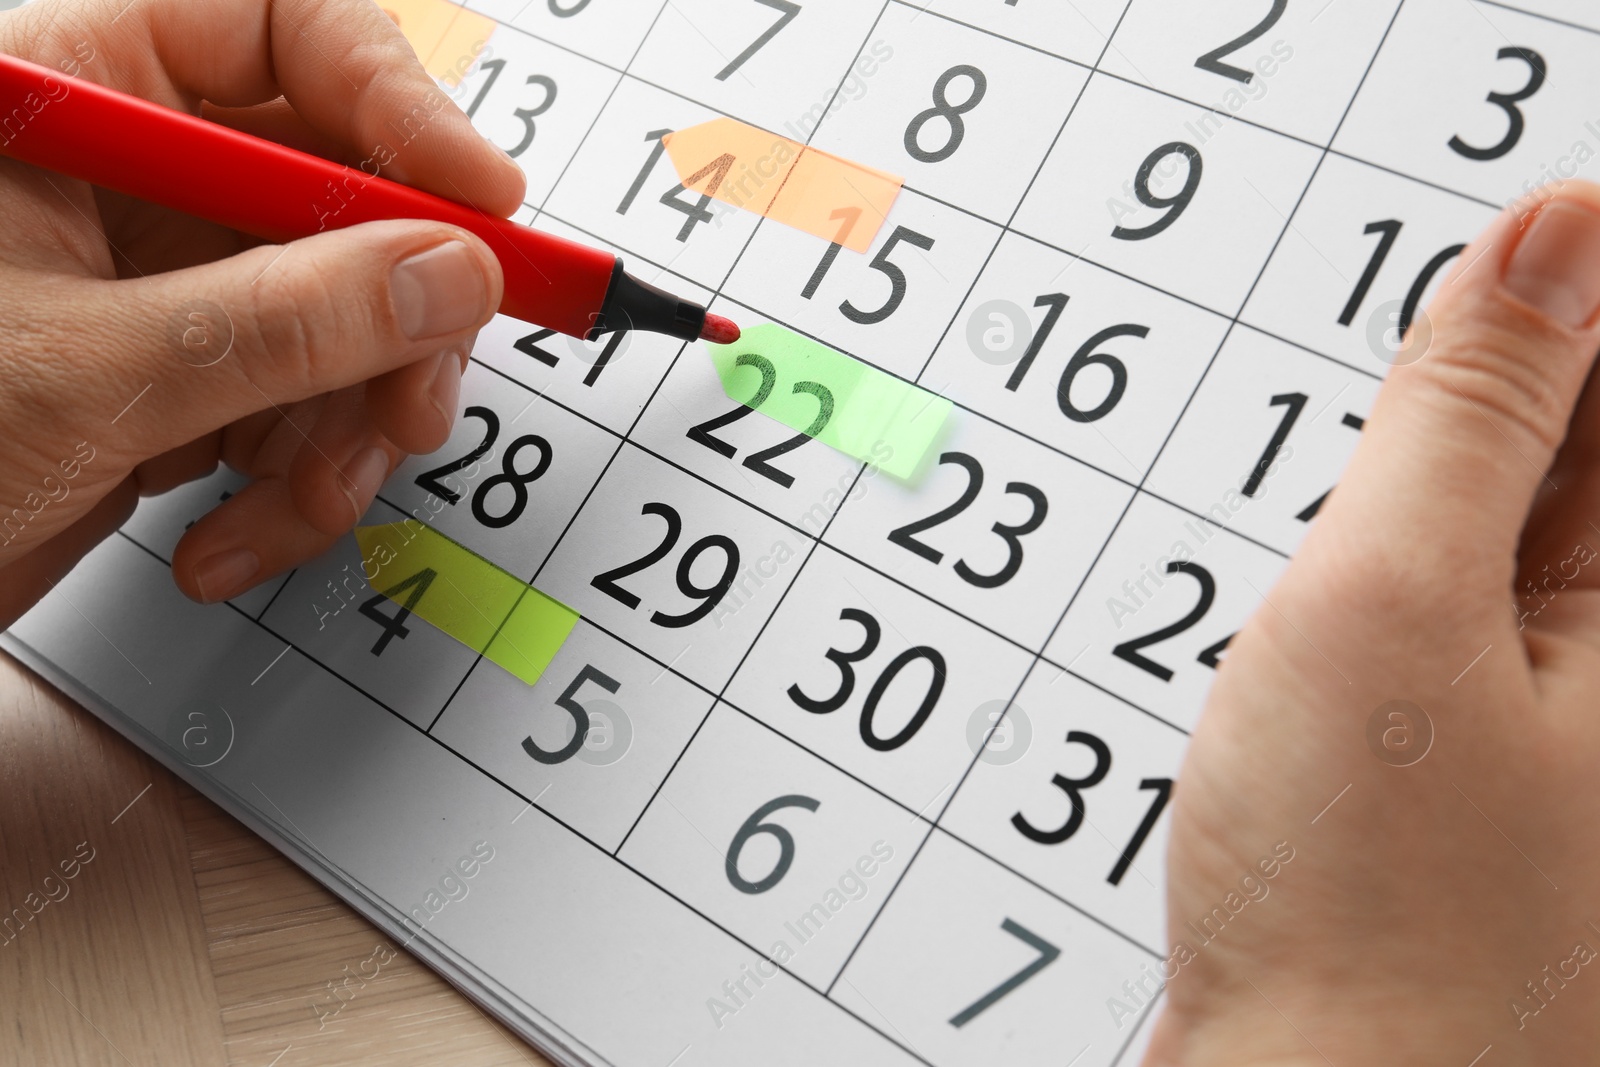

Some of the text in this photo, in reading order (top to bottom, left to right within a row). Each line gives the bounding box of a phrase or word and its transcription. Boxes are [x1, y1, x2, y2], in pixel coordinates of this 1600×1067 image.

[1194, 0, 1288, 84] 2
[466, 57, 557, 158] 13
[904, 64, 987, 163] 8
[1447, 46, 1547, 161] 3
[616, 127, 736, 243] 14
[1111, 141, 1203, 241] 9
[800, 205, 936, 325] 15
[1004, 293, 1151, 424] 16
[414, 405, 553, 528] 28
[685, 353, 835, 490] 22
[590, 501, 741, 629] 29
[886, 451, 1048, 589] 23
[357, 567, 438, 658] 4
[1111, 560, 1239, 683] 2
[520, 663, 622, 766] 5
[786, 607, 947, 753] 30
[724, 794, 821, 896] 6
[1010, 730, 1176, 888] 31
[948, 917, 1062, 1029] 7
